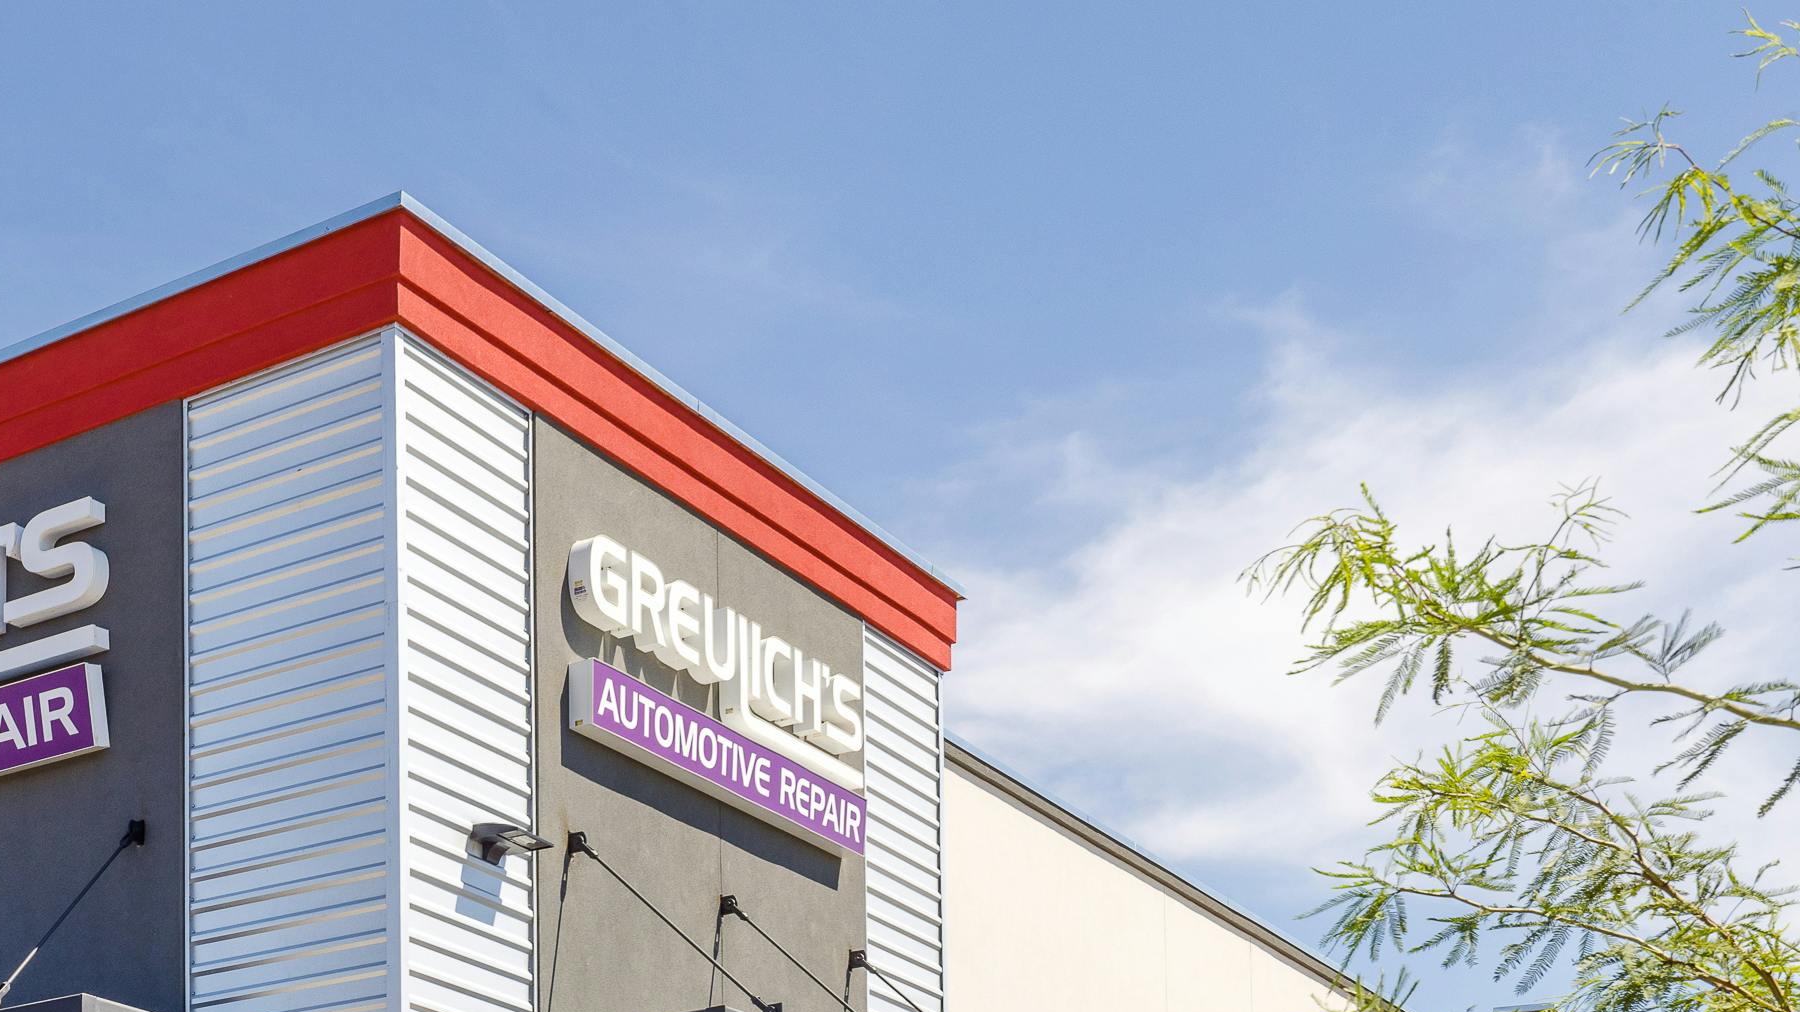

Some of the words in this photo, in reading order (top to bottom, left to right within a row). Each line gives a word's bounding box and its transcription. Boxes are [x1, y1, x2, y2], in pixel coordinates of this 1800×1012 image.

[569, 534, 864, 790] GREULICH'S
[598, 678, 771, 796] AUTOMOTIVE
[779, 766, 862, 844] REPAIR
